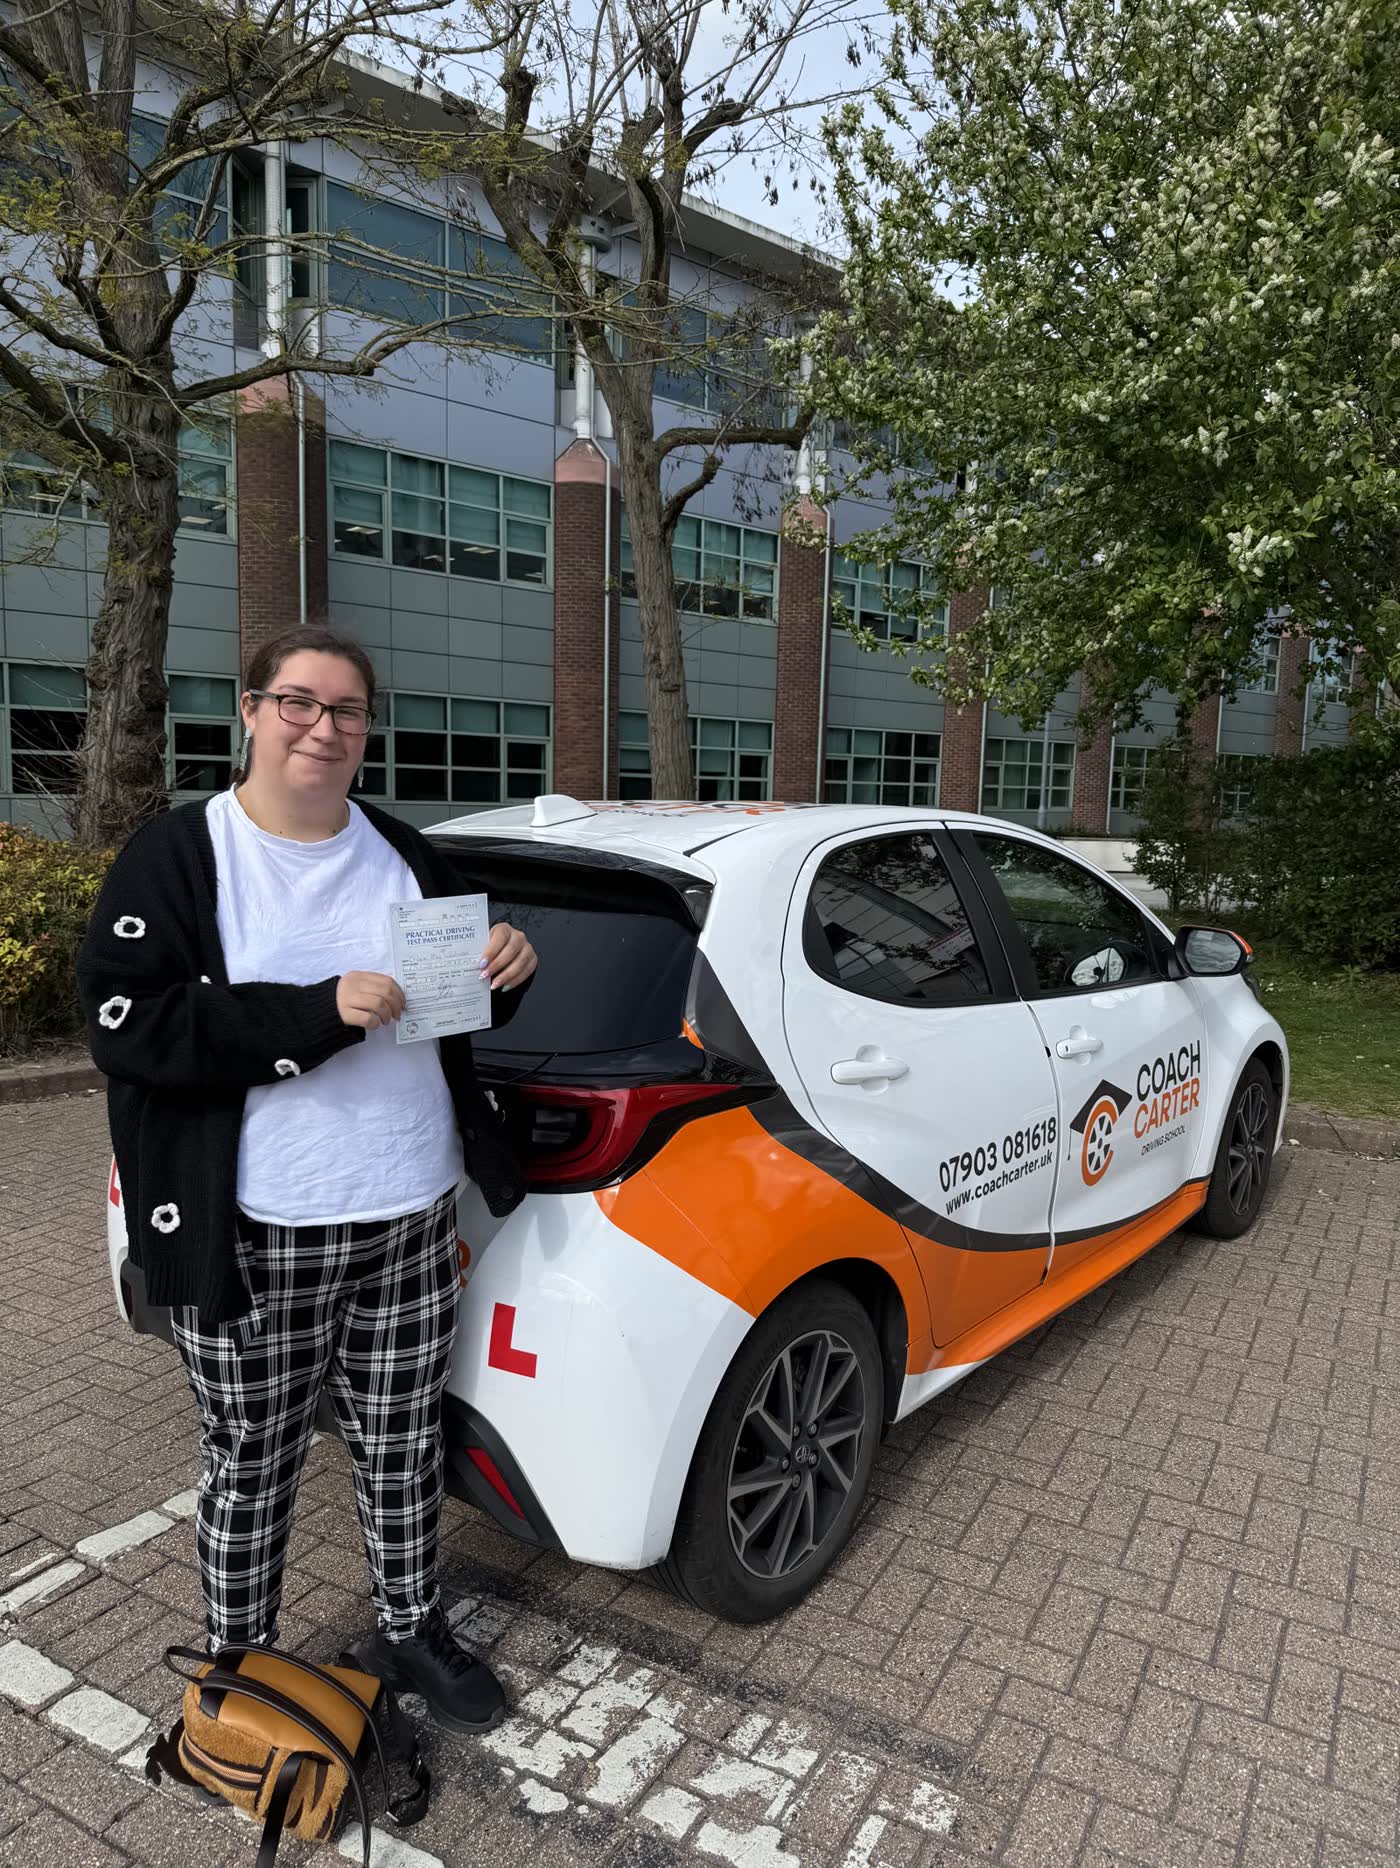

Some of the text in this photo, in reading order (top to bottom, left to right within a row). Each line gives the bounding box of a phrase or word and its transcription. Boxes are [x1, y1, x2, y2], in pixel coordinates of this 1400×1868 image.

[405, 926, 476, 939] PRACTICAL DRIVING
[407, 932, 476, 946] TEST PASS CERTIFICATE
[1136, 1039, 1201, 1102] COACH
[1133, 1077, 1200, 1139] CARTER
[938, 1116, 1057, 1193] 07903 081618
[1141, 1125, 1186, 1156] DRIVING SCHOOL
[945, 1149, 1053, 1216] www.coachcarter.uk
[487, 1301, 538, 1379] L
